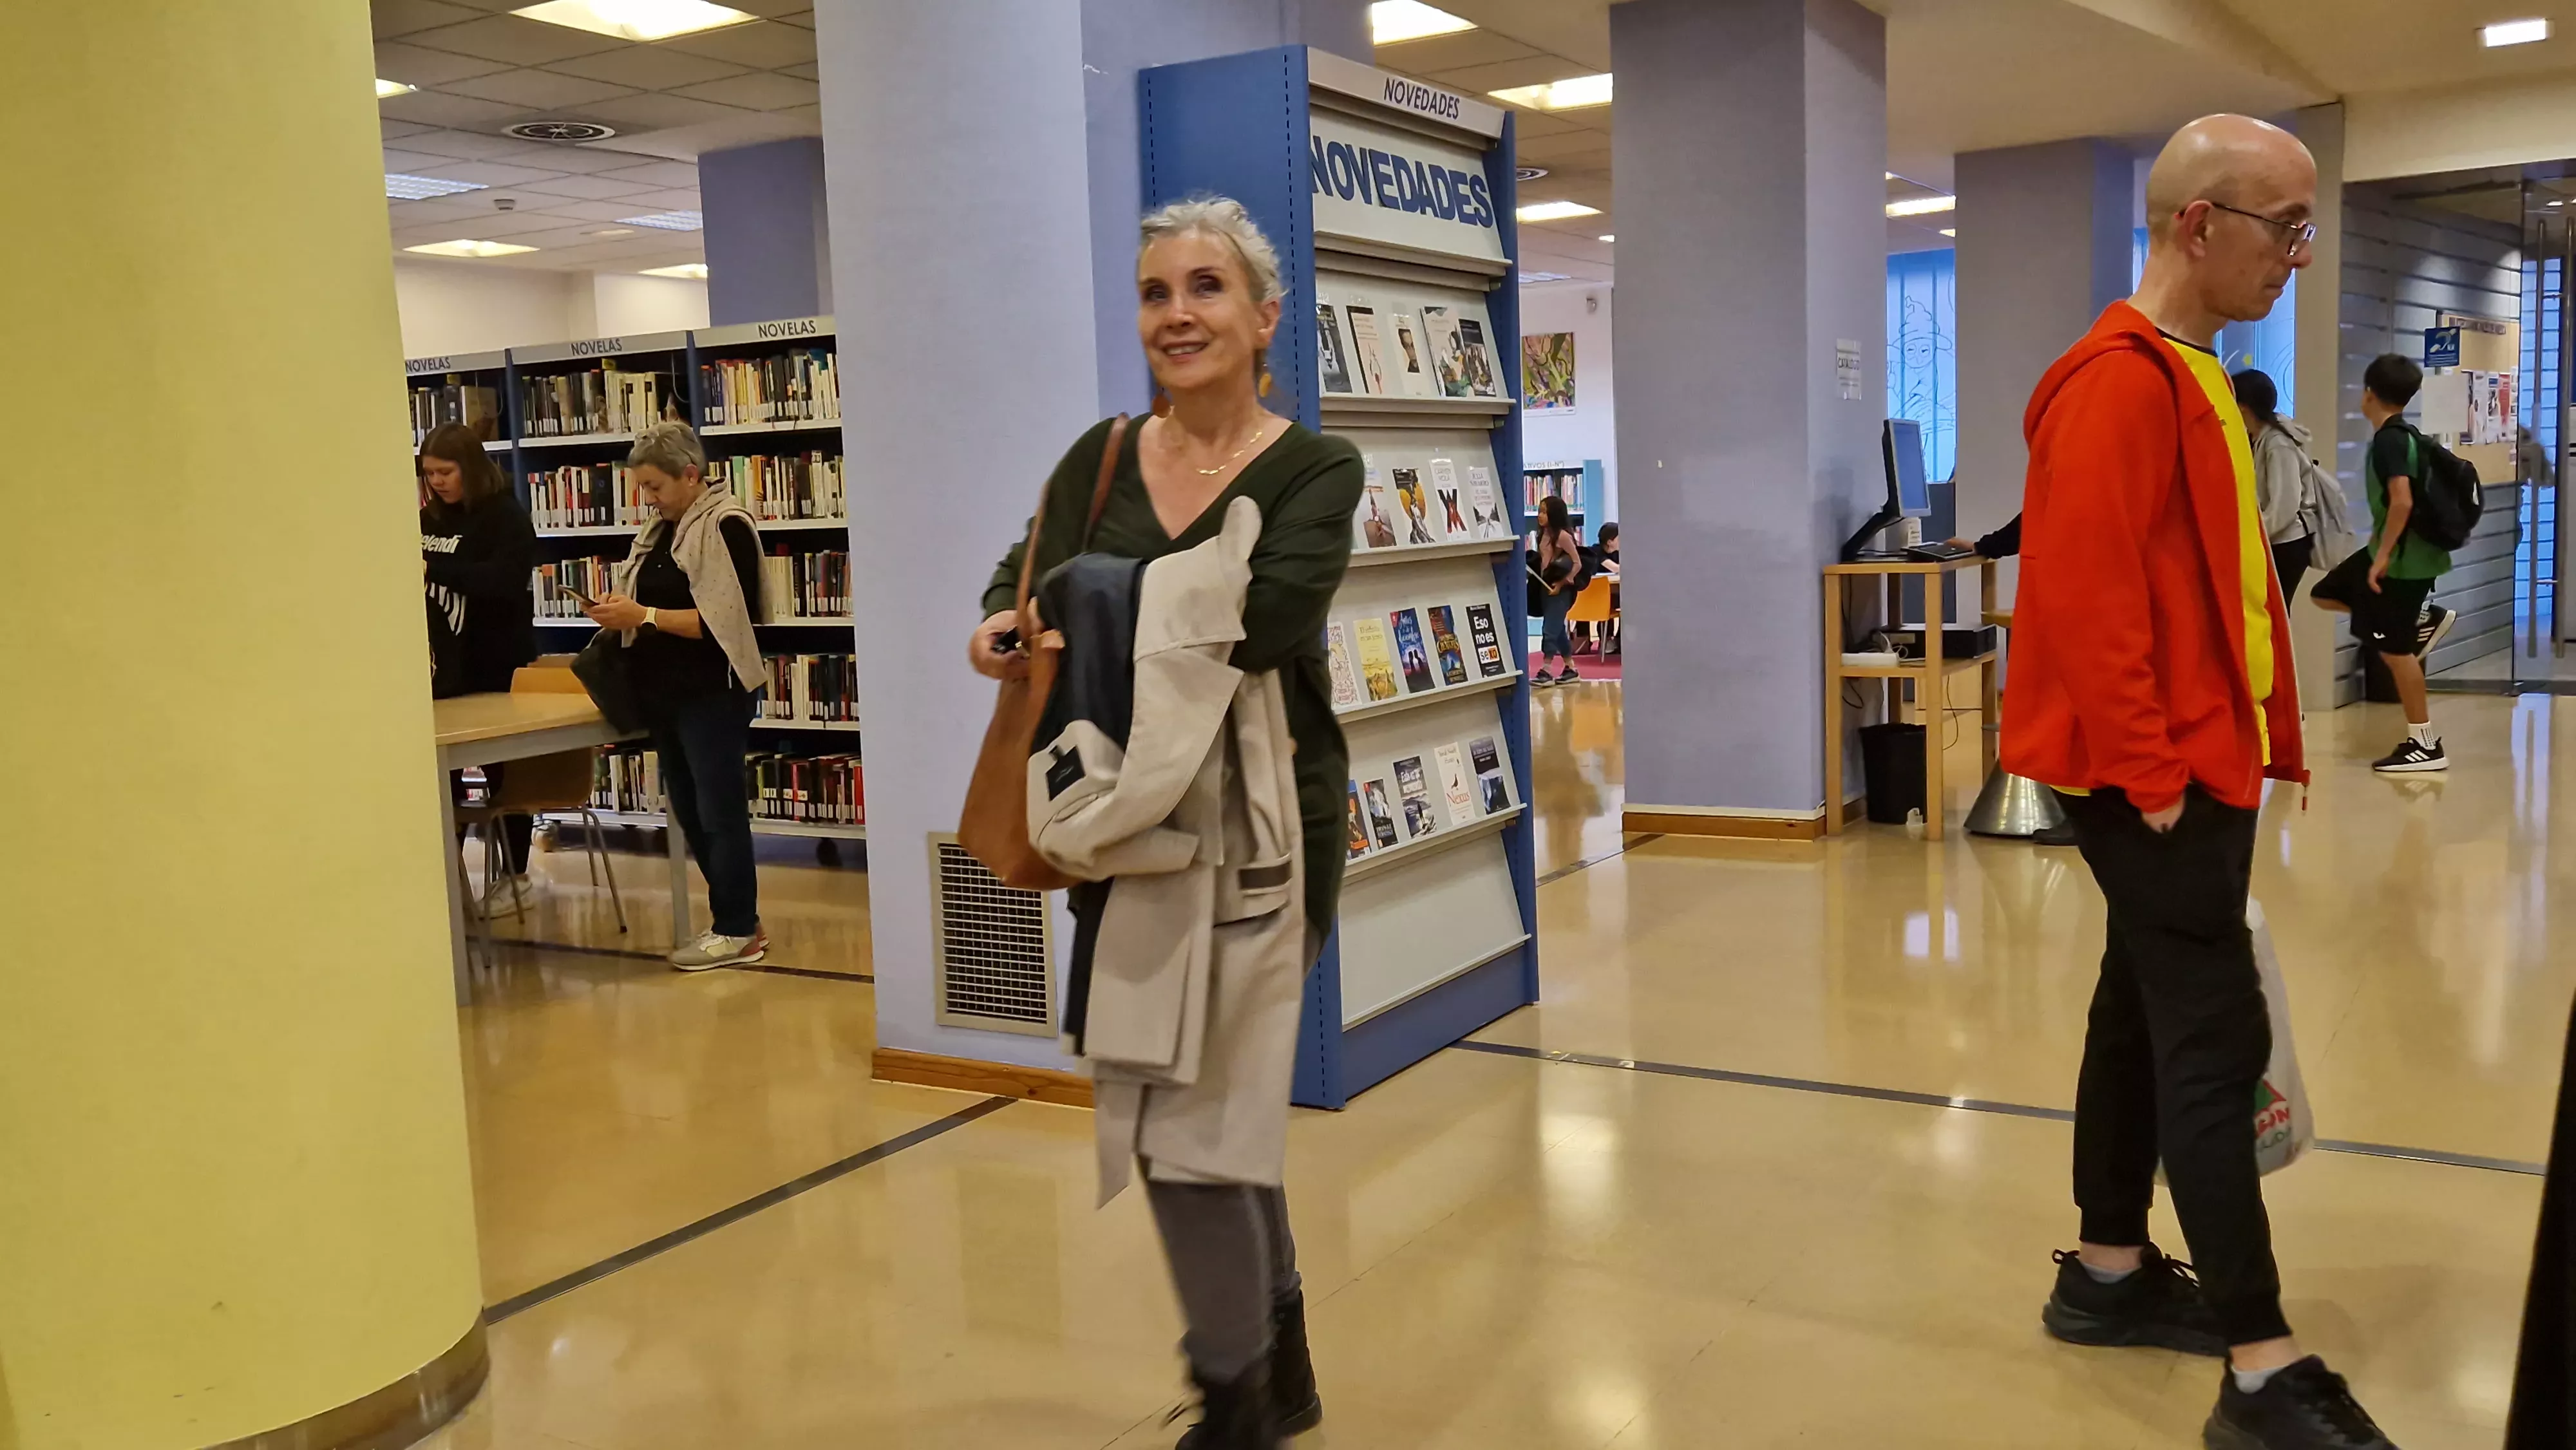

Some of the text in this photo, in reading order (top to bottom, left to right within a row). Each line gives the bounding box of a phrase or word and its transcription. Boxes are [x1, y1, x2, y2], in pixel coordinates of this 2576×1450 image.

[1384, 77, 1460, 120] NOVEDADES
[1310, 135, 1493, 229] NOVEDADES
[758, 320, 816, 338] NOVELAS
[571, 338, 623, 356] NOVELAS
[405, 357, 451, 372] NOVELAS
[1473, 616, 1489, 630] Eso
[1475, 632, 1495, 645] no es
[1480, 649, 1498, 661] sexo
[1446, 791, 1470, 807] Nexus
